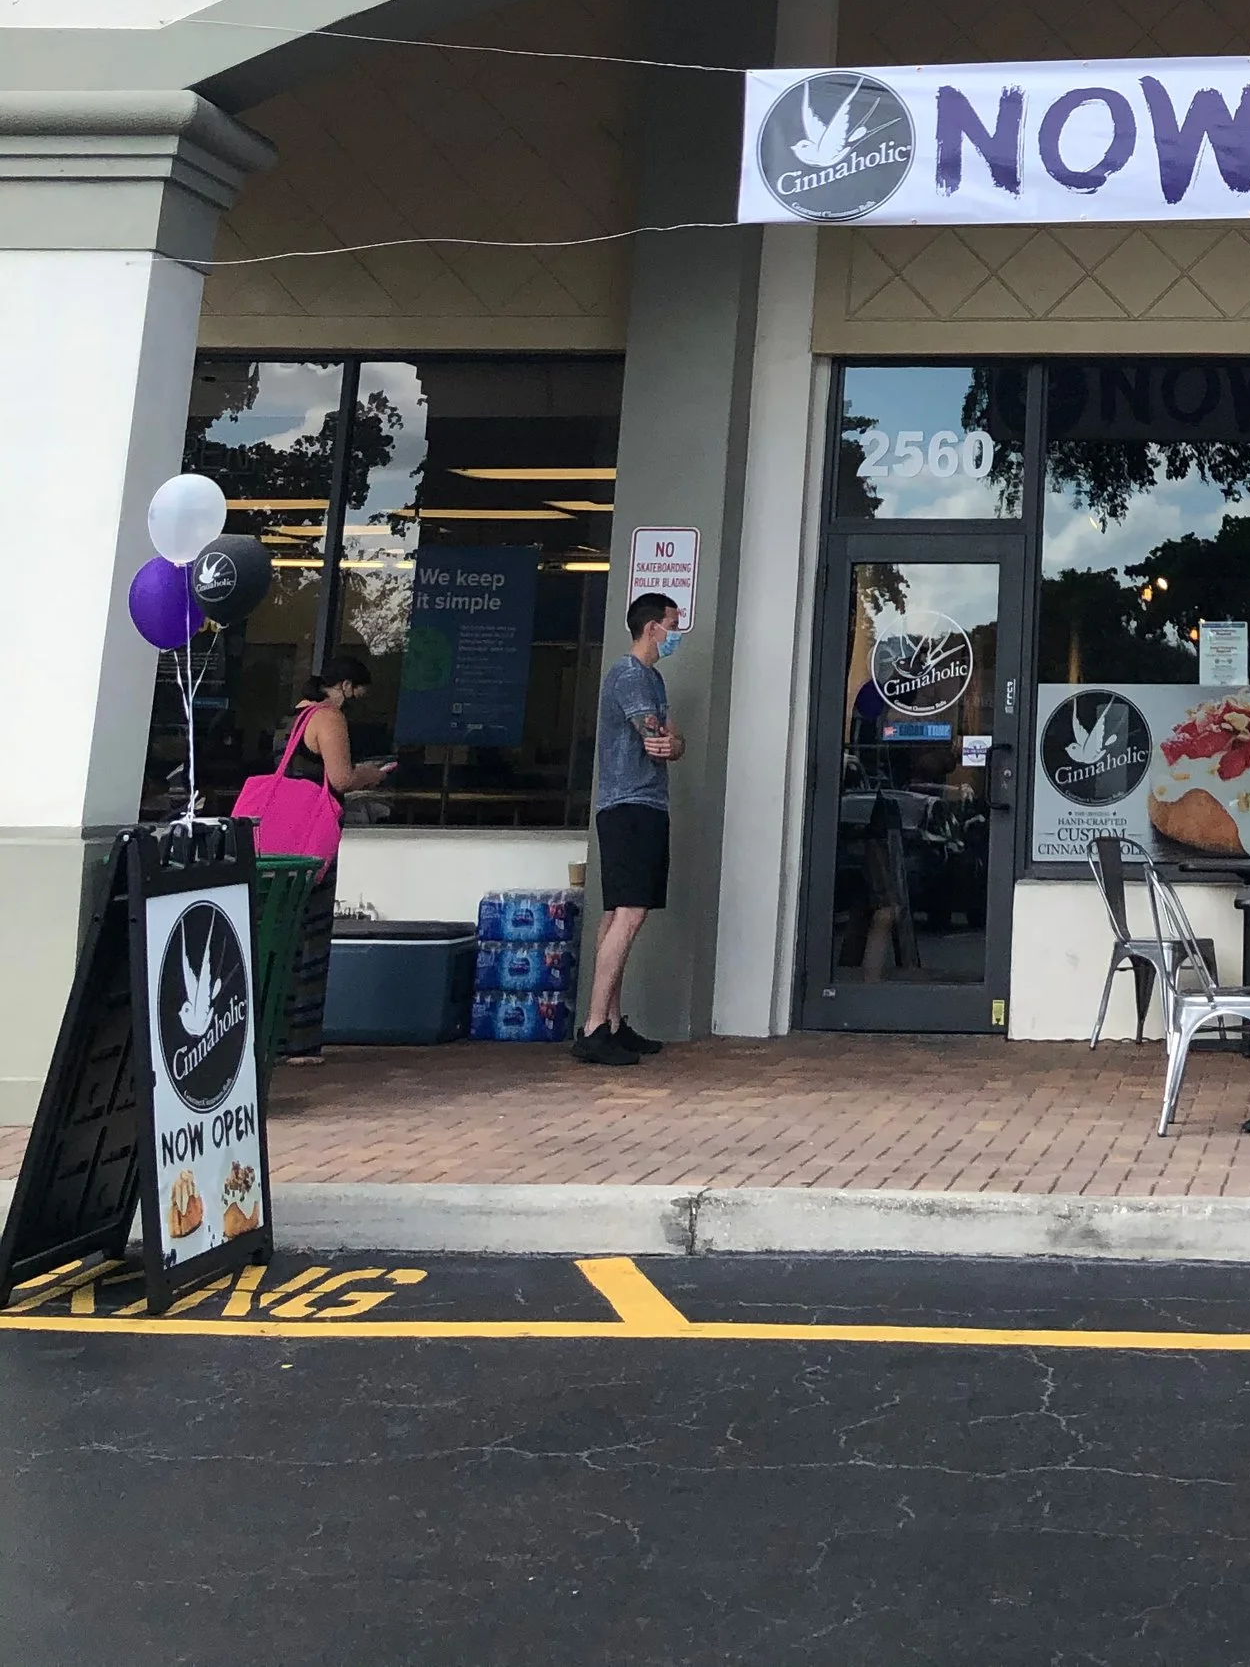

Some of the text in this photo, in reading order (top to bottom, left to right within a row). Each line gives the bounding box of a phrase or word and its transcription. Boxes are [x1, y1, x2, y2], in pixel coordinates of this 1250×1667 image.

[777, 140, 908, 195] Cinnaholic
[856, 430, 994, 478] 2560
[655, 541, 675, 557] NO
[636, 562, 691, 573] SKATEBOARDING
[419, 568, 505, 590] We keep
[634, 577, 691, 587] ROLLER BLADING
[416, 592, 502, 614] it simple
[884, 660, 968, 697] Cinnaholic
[1055, 745, 1147, 785] Cinnaholic
[1057, 817, 1128, 826] HAND-CRAFTED
[1057, 827, 1127, 842] CUSTOM
[173, 994, 246, 1081] Cinnaholic
[161, 1102, 255, 1169] NOW OPEN
